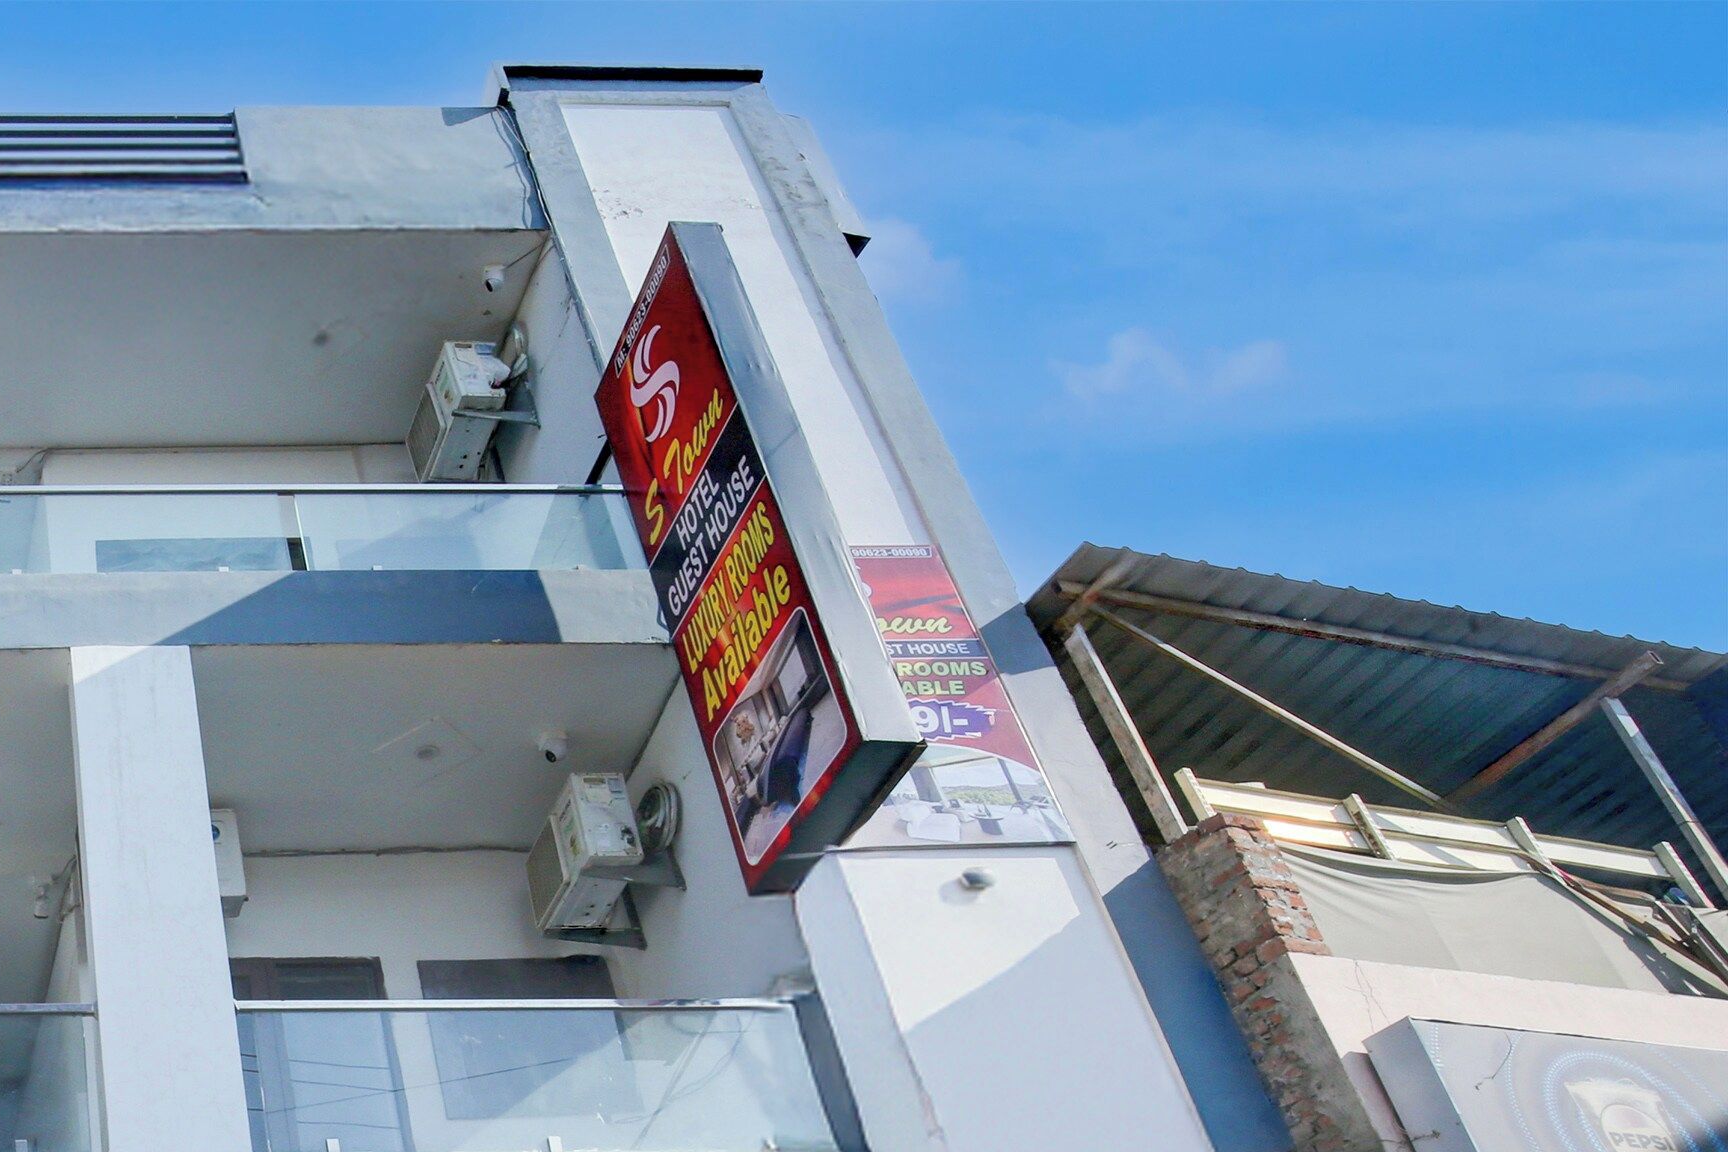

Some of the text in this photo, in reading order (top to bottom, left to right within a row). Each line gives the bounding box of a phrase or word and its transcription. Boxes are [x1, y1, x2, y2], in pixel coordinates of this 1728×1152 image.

[625, 255, 668, 348] 90623-00090
[645, 387, 725, 546] S Town
[676, 467, 721, 552] HOTEL
[667, 456, 756, 616] GUEST HOUSE
[680, 500, 776, 675] LUXURY ROOMS
[876, 616, 953, 635] own
[701, 563, 792, 724] Available
[896, 661, 989, 677] ROOMS
[907, 642, 971, 655] HOUSE
[1608, 1131, 1675, 1152] PEPSI
